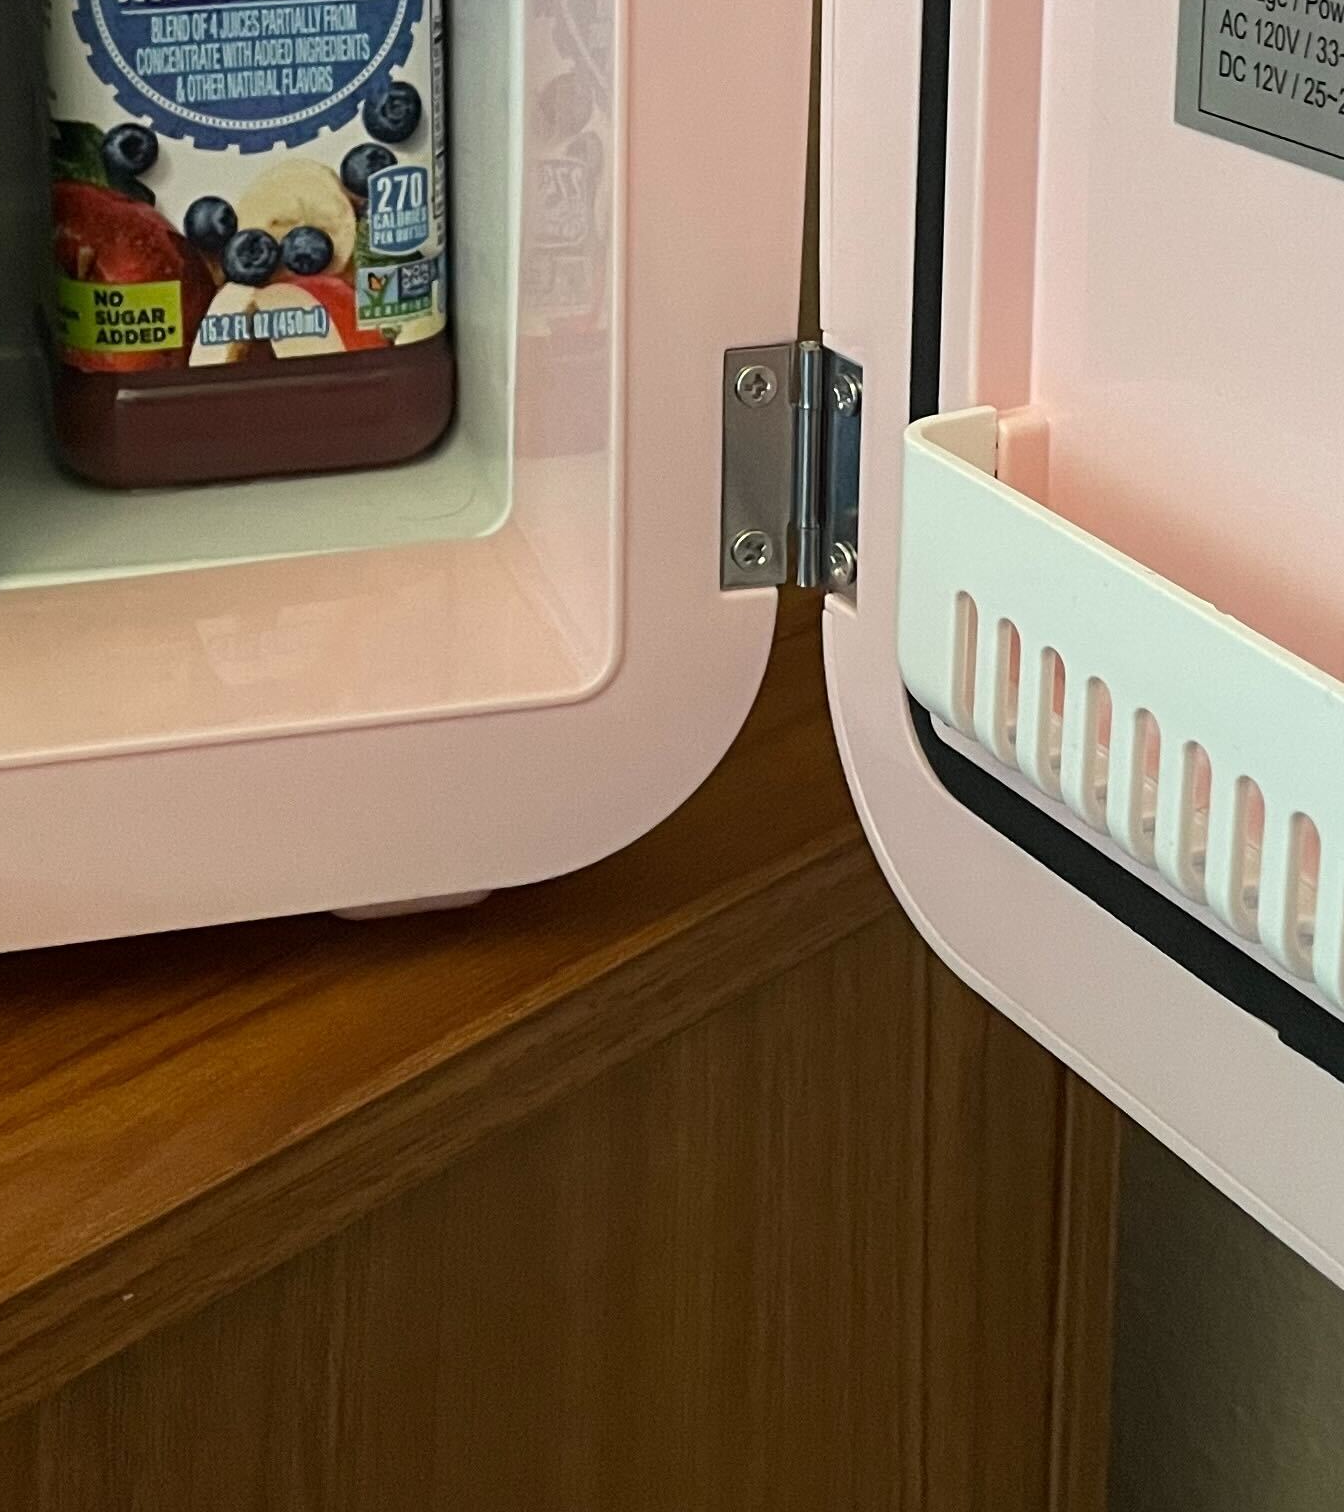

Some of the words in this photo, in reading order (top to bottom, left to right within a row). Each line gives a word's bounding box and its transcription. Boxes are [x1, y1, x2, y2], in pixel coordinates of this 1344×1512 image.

[151, 15, 190, 43] BLEND
[192, 13, 207, 39] OF
[210, 12, 217, 38] 4
[220, 9, 259, 38] JUICES
[262, 4, 321, 35] PARTIALLY
[323, 3, 356, 31] FROM
[1220, 8, 1247, 40] AC
[1254, 17, 1301, 55] 120V
[1304, 31, 1312, 60] /
[136, 43, 221, 76] CONCENTRATE
[222, 41, 252, 68] WITH
[255, 38, 293, 65] ADDED
[295, 34, 370, 63] INGREDIENTS
[1219, 51, 1246, 82] DC
[1253, 59, 1287, 95] 12V
[1290, 70, 1298, 99] /
[176, 76, 186, 103] &
[187, 73, 226, 101] OTHER
[227, 68, 280, 97] NATURAL
[282, 66, 333, 95] FLAVORS
[377, 172, 423, 212] 270
[94, 290, 123, 307] NO
[95, 308, 165, 326] SUGAR
[202, 317, 230, 344] 15.2
[235, 313, 249, 340] FL
[255, 313, 269, 337] OZ
[273, 307, 327, 339] (450mL)
